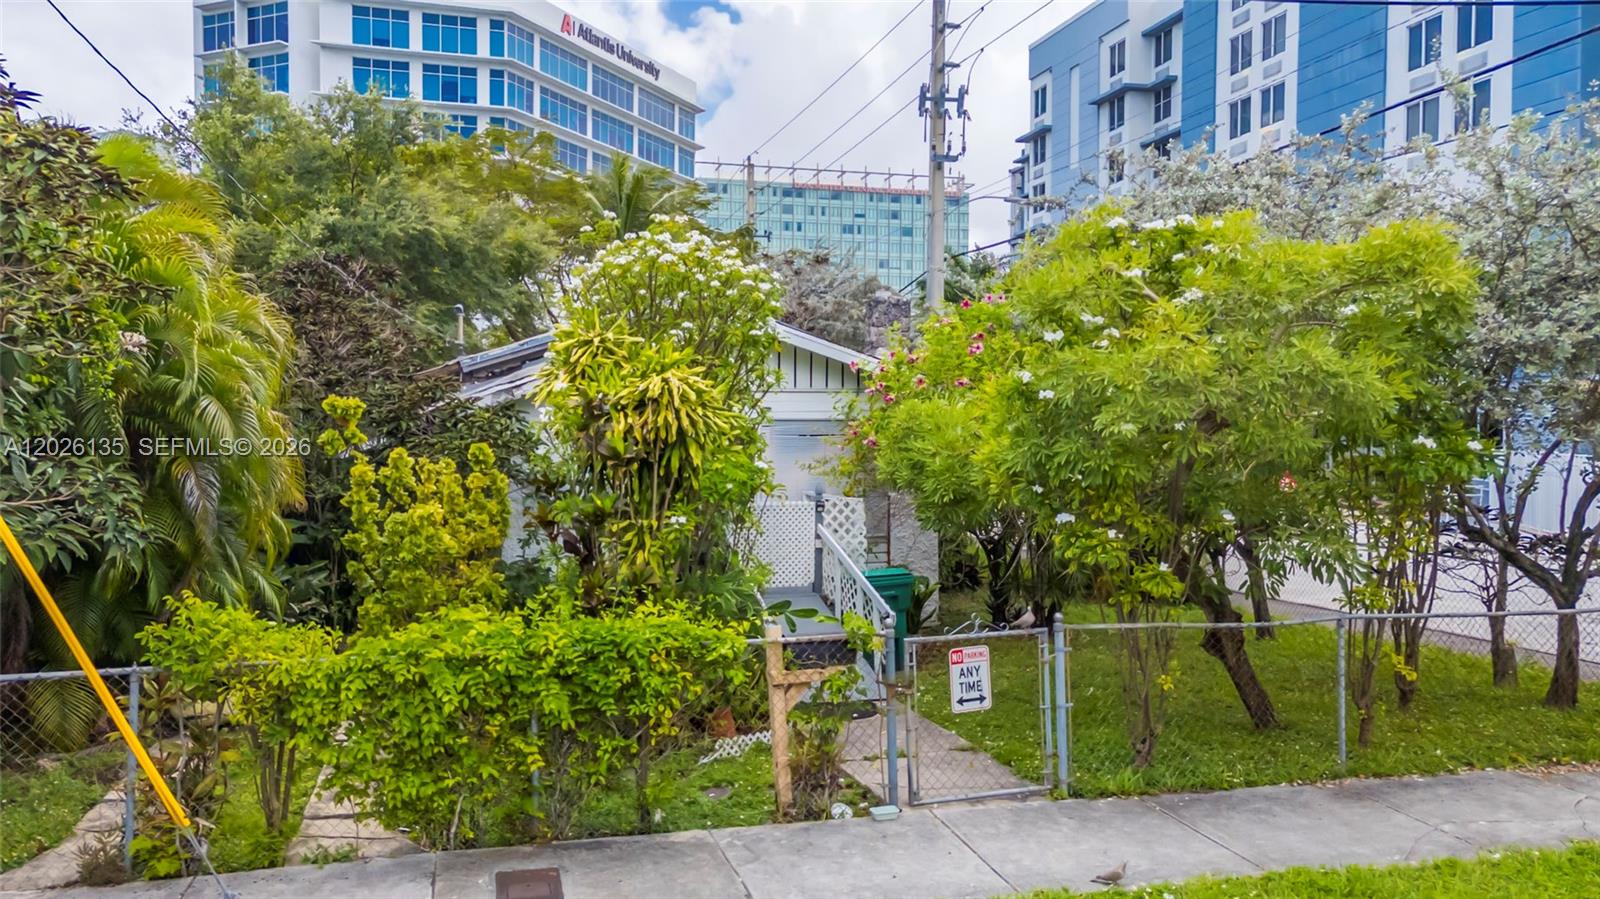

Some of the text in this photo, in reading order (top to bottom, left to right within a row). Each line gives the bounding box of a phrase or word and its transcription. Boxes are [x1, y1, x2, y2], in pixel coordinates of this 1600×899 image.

[577, 23, 615, 55] Atlantis
[616, 43, 660, 81] University
[951, 651, 987, 663] NO PARKING
[959, 665, 981, 679] ANY
[959, 680, 983, 694] TIME
